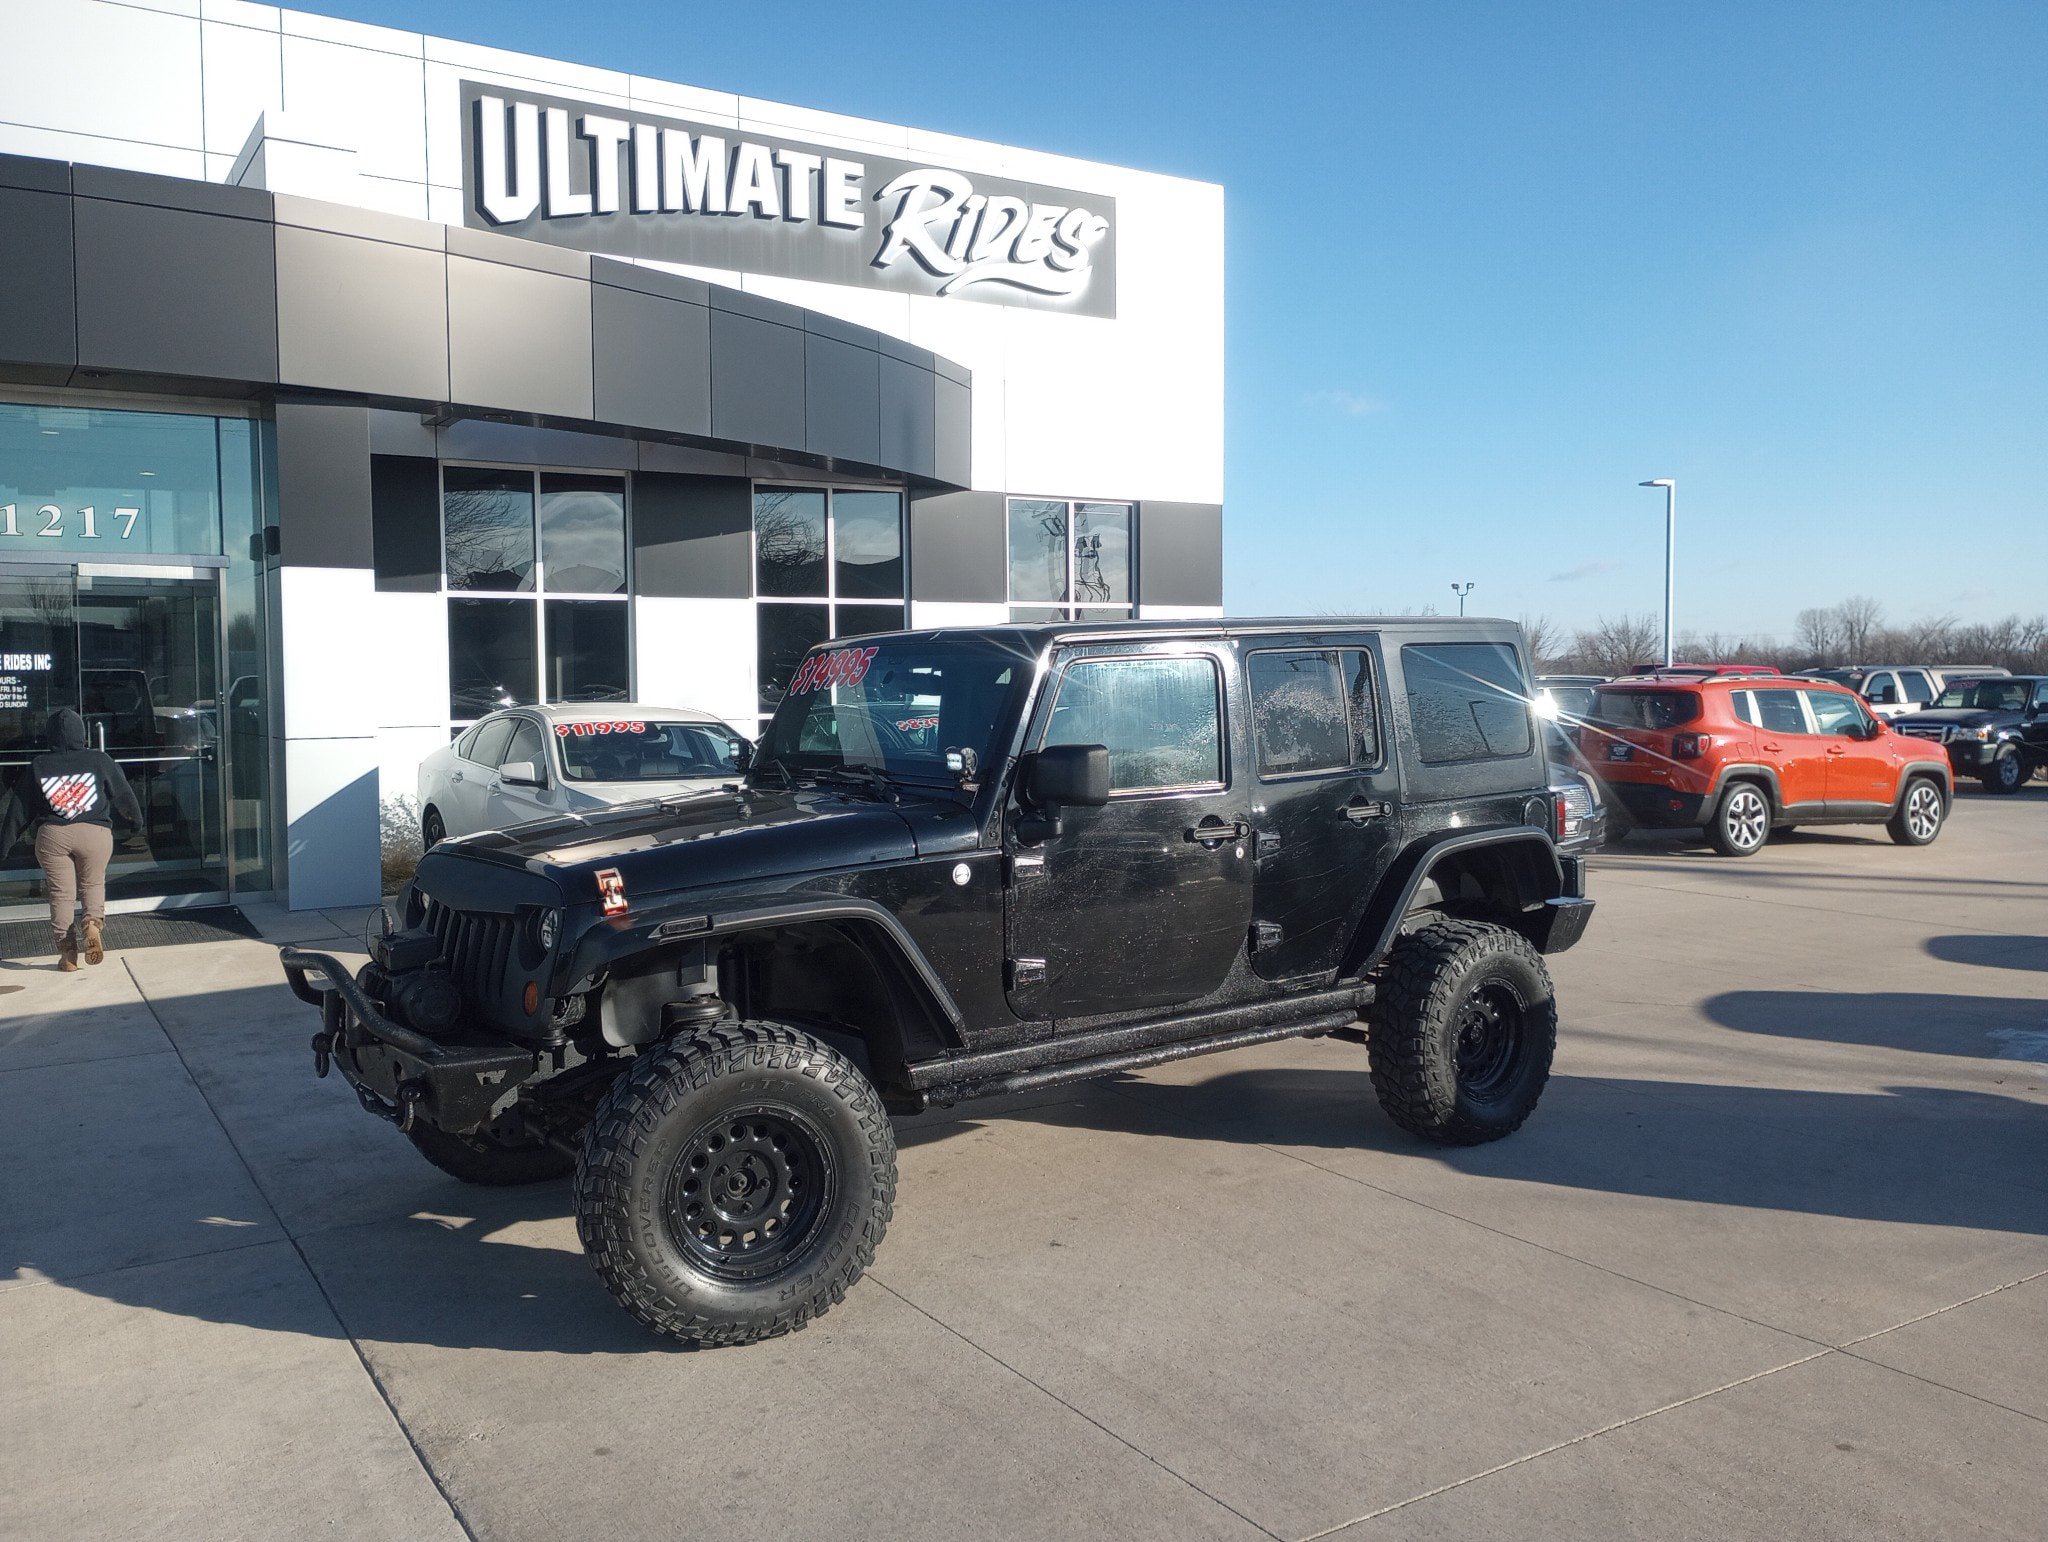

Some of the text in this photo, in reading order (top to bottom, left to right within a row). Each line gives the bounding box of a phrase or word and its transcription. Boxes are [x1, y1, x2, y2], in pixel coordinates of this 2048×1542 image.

[477, 95, 1109, 294] ULTIMATE RIDES
[0, 503, 140, 539] 1217
[3, 654, 32, 670] RIDES
[34, 654, 52, 670] INC
[790, 646, 880, 696] $14995
[0, 676, 17, 685] URS
[555, 721, 646, 737] $11995
